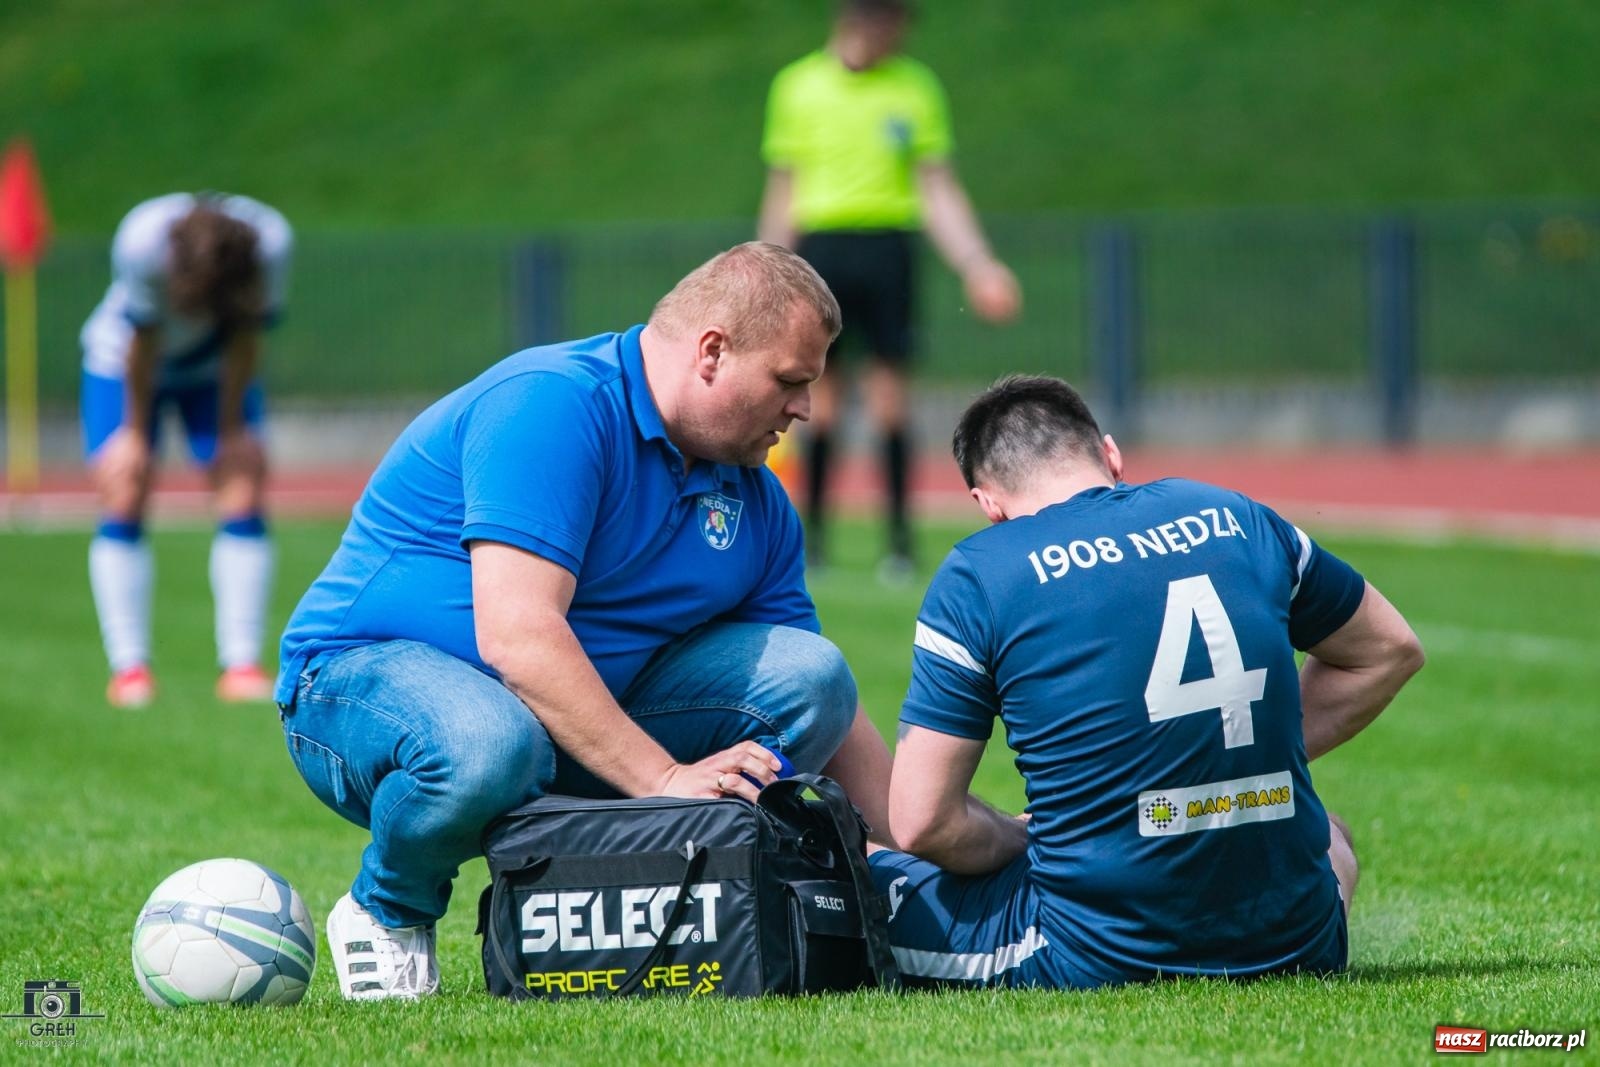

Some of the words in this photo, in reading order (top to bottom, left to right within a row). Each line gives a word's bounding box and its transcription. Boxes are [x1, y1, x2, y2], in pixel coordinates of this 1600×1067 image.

[1028, 537, 1123, 584] 1908
[1127, 507, 1247, 558] NĘDZA
[1144, 574, 1268, 750] 4
[1186, 786, 1291, 818] MAN-TRANS
[521, 883, 722, 954] SELECT
[814, 895, 845, 912] SELECT
[525, 964, 691, 993] PROFCRE
